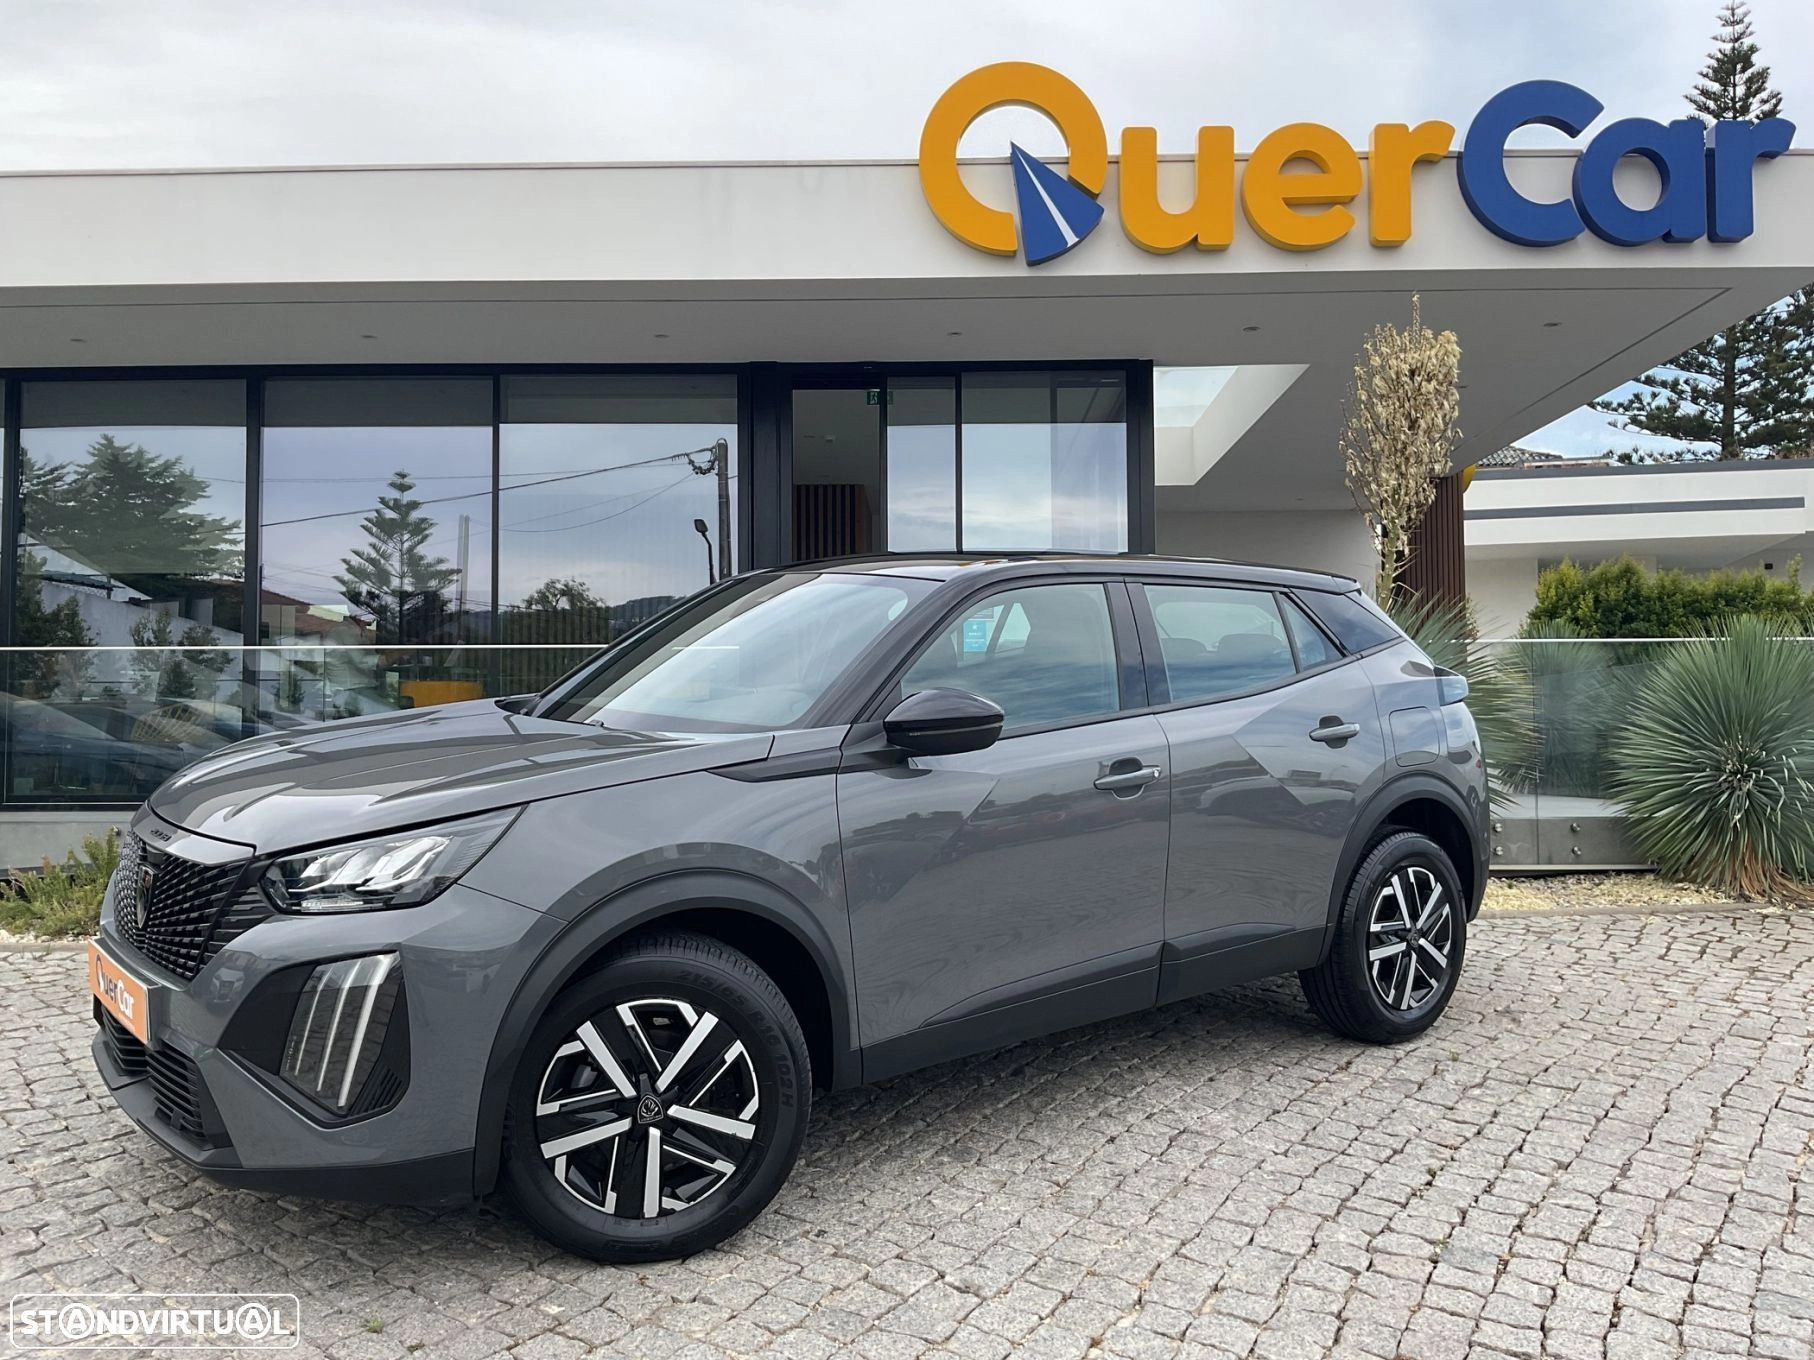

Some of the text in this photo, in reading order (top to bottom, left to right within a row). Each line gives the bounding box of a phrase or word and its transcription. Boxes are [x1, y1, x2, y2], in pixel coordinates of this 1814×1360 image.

[919, 61, 1796, 266] QuerCar
[96, 953, 134, 1019] QuerCar
[776, 1053, 795, 1108] 102H
